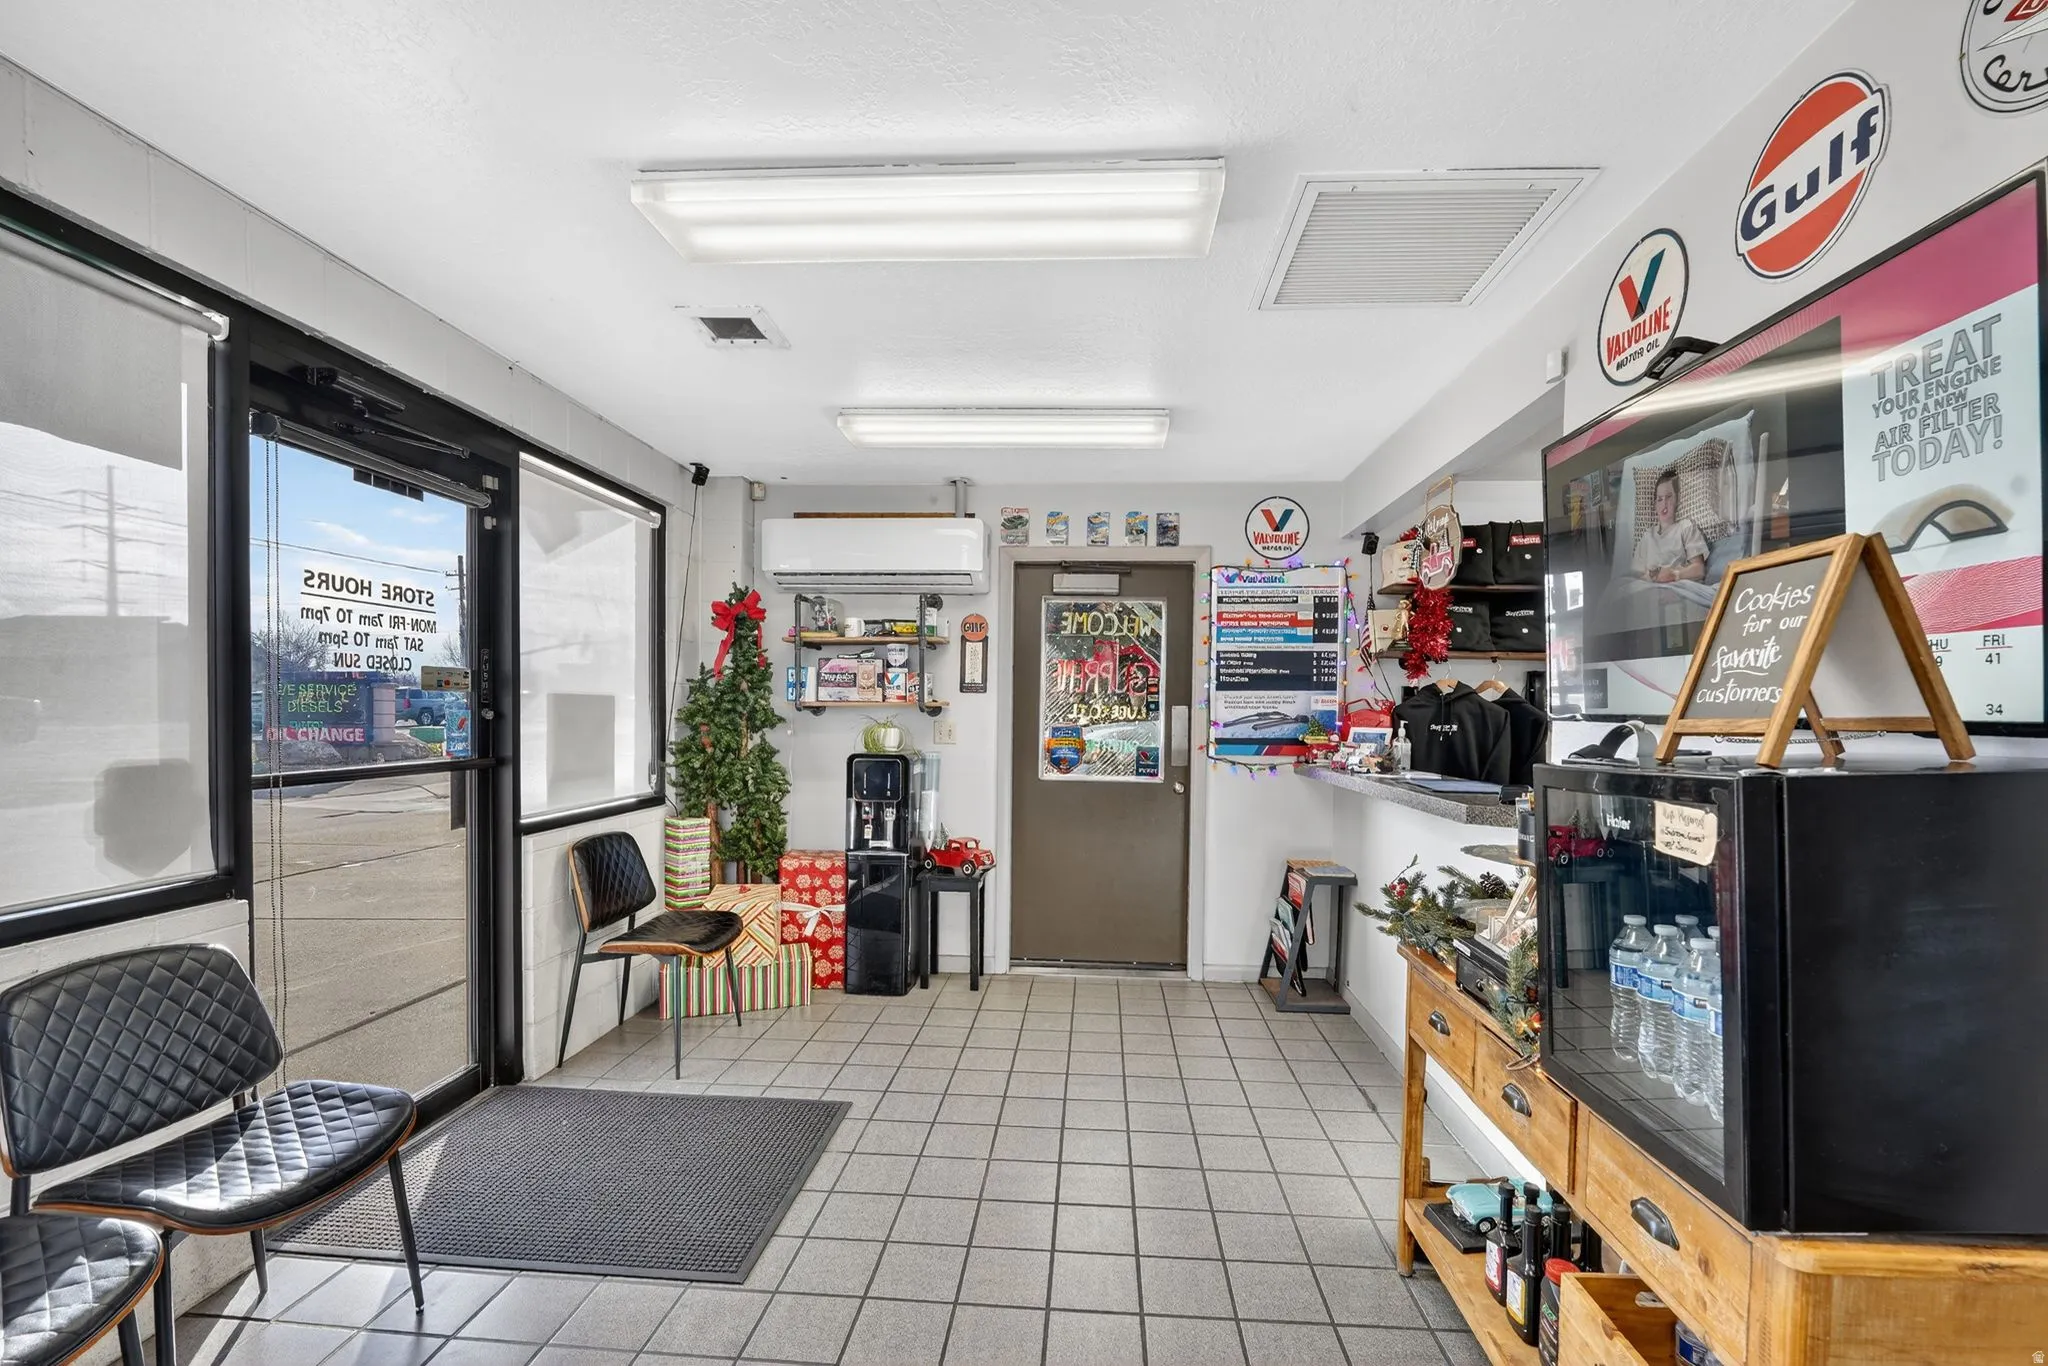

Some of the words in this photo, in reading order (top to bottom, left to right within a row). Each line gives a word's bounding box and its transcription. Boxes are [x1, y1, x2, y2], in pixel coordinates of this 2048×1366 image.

[1740, 105, 1880, 241] Gulf
[1606, 296, 1672, 367] VALVOLINE
[1616, 347, 1644, 371] MOTOR
[1646, 338, 1660, 353] OIL
[1870, 313, 2002, 401] TREAT
[1872, 388, 1920, 419] YOUR
[1924, 355, 2002, 400] ENGINE
[1900, 407, 1917, 423] TO
[1921, 402, 1931, 416] A
[1934, 387, 1968, 412] NEW
[1874, 423, 1913, 453] AIR
[1919, 392, 2001, 438] FILTER
[1872, 414, 2003, 482] TODAY!
[1735, 582, 1816, 613] Cookies
[1742, 614, 1772, 637] for
[1779, 615, 1808, 630] our
[1983, 634, 2005, 647] FRI
[1711, 636, 1783, 684] favorite
[1985, 653, 2001, 664] 41
[298, 684, 356, 696] SERVICE
[1696, 678, 1784, 704] customers
[1986, 704, 2003, 715] 34
[298, 727, 365, 742] CHANGE
